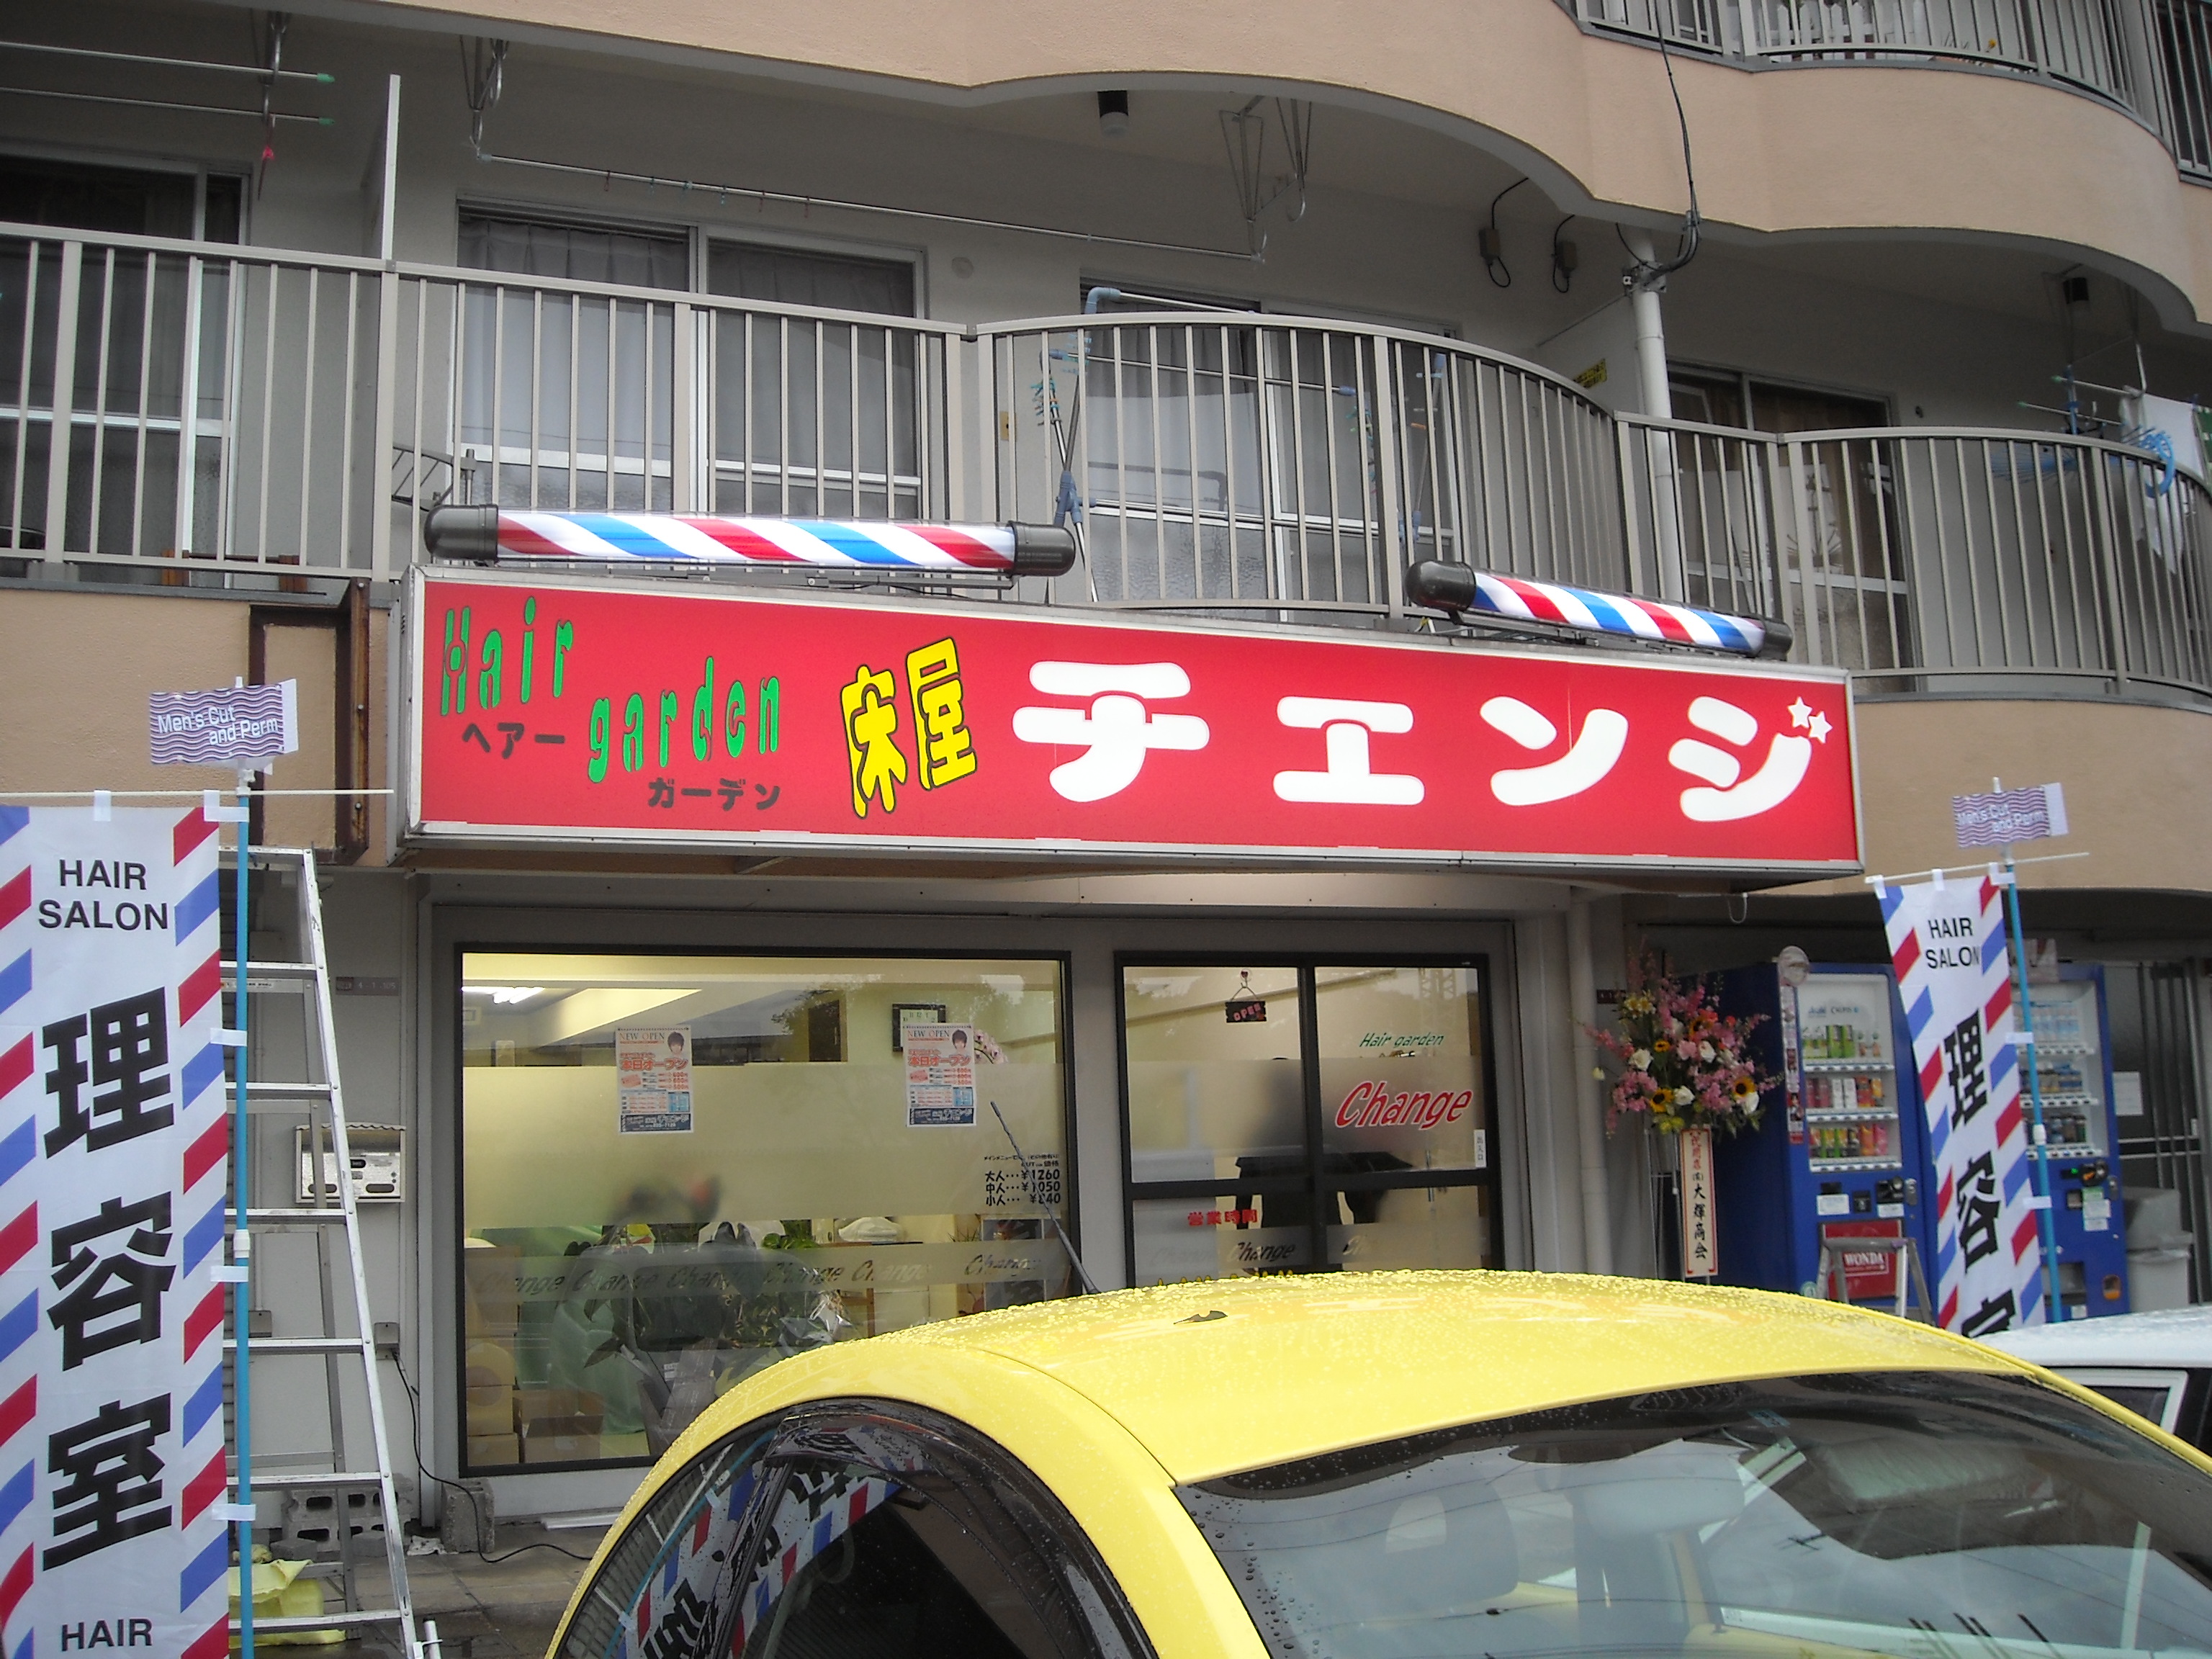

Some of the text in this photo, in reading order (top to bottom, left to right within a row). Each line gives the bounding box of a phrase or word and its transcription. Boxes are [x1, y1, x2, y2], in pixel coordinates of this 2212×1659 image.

[440, 596, 572, 716] Hair
[158, 704, 235, 734] Men's Cut
[209, 718, 279, 745] and Perm
[588, 656, 780, 783] garden
[840, 637, 978, 819] 床屋
[462, 721, 565, 759] ヘアー
[648, 778, 780, 811] ガーデン
[59, 859, 147, 891] HAIR
[38, 899, 168, 931] SALON
[1928, 917, 1974, 939] HAIR
[1925, 945, 1980, 969] SALON
[1233, 1002, 1261, 1021] OPEN
[1359, 1032, 1445, 1049] Hair garden
[1335, 1081, 1474, 1130] Change
[1227, 1242, 1296, 1262] Change
[42, 986, 177, 1572] 理容室
[62, 1618, 153, 1652] HAIR
